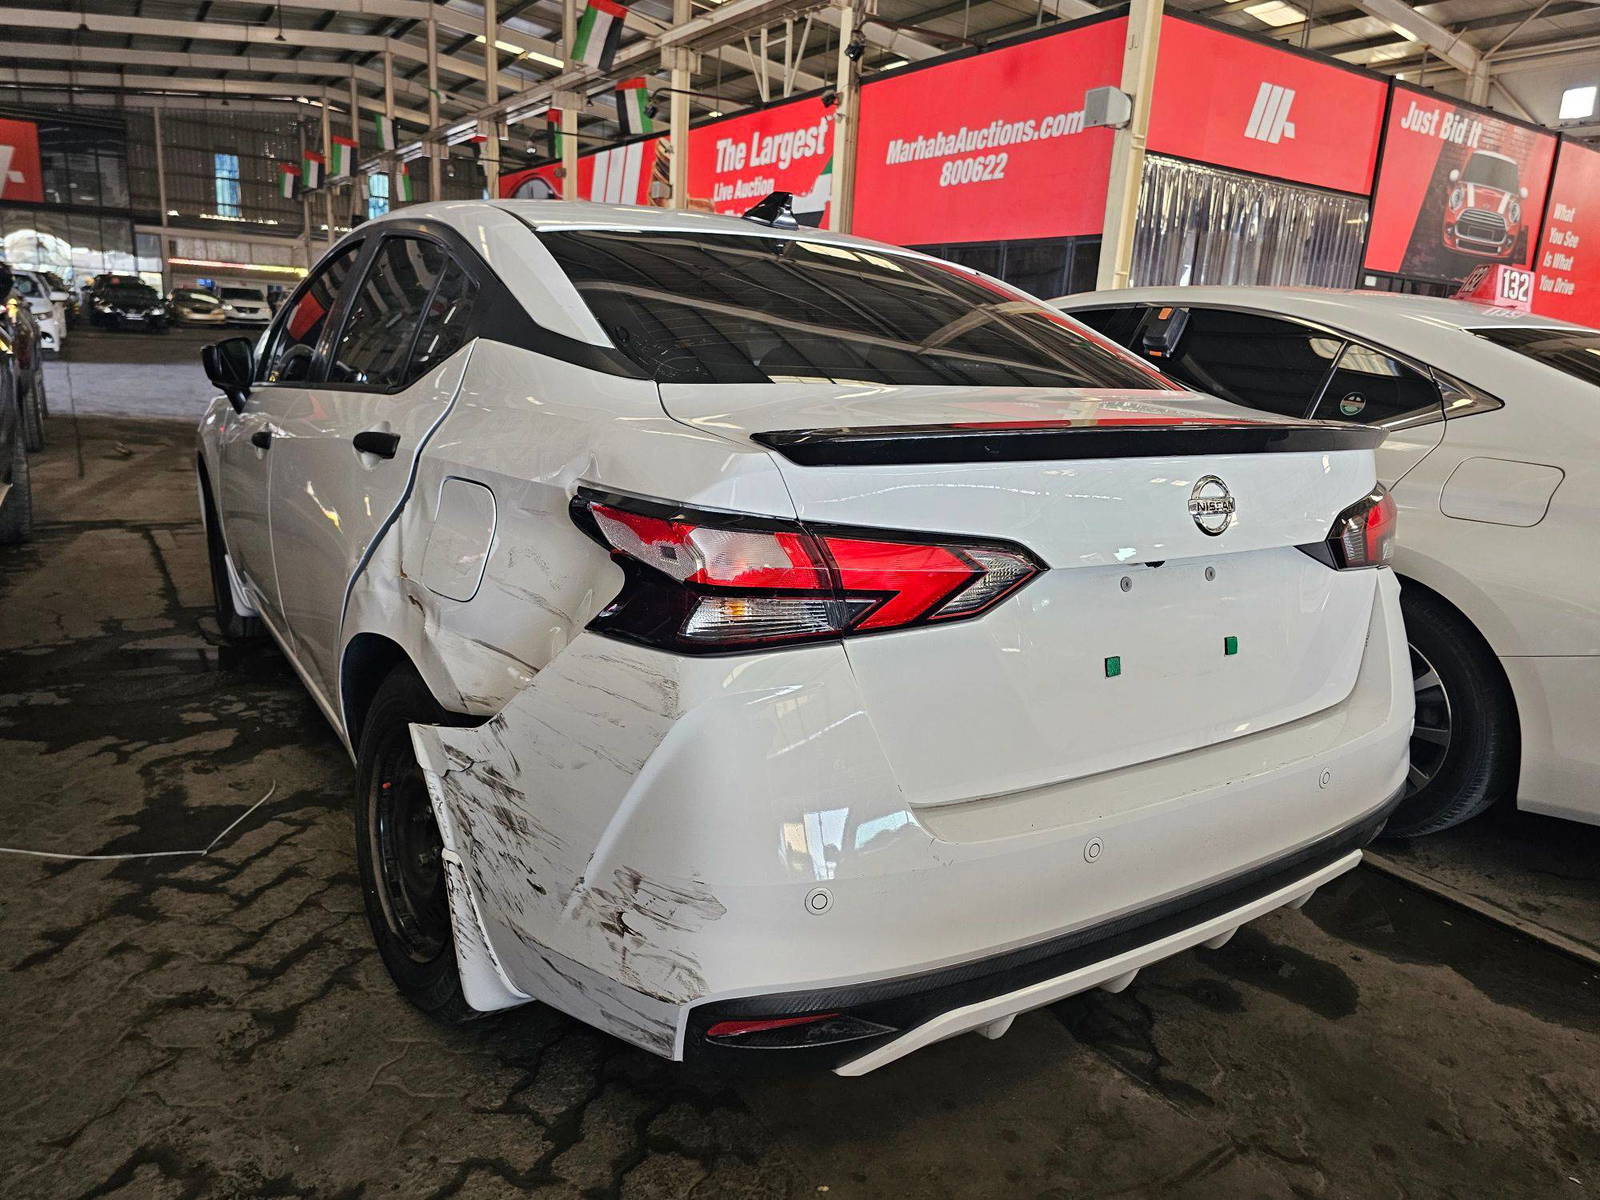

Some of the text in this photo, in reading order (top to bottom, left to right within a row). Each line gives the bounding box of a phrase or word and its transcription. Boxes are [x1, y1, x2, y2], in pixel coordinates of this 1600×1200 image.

[886, 111, 1084, 164] MarhabaAuctions.com
[1401, 101, 1482, 148] Just Bid It
[716, 117, 828, 172] The Largest
[939, 152, 1008, 187] 800622
[713, 176, 774, 202] Live Auction
[1553, 203, 1575, 222] What
[1549, 227, 1580, 249] You See
[1543, 251, 1574, 271] Is What
[1502, 269, 1529, 301] 132
[1540, 275, 1575, 295] You Drive
[1197, 501, 1234, 512] NISSAN
